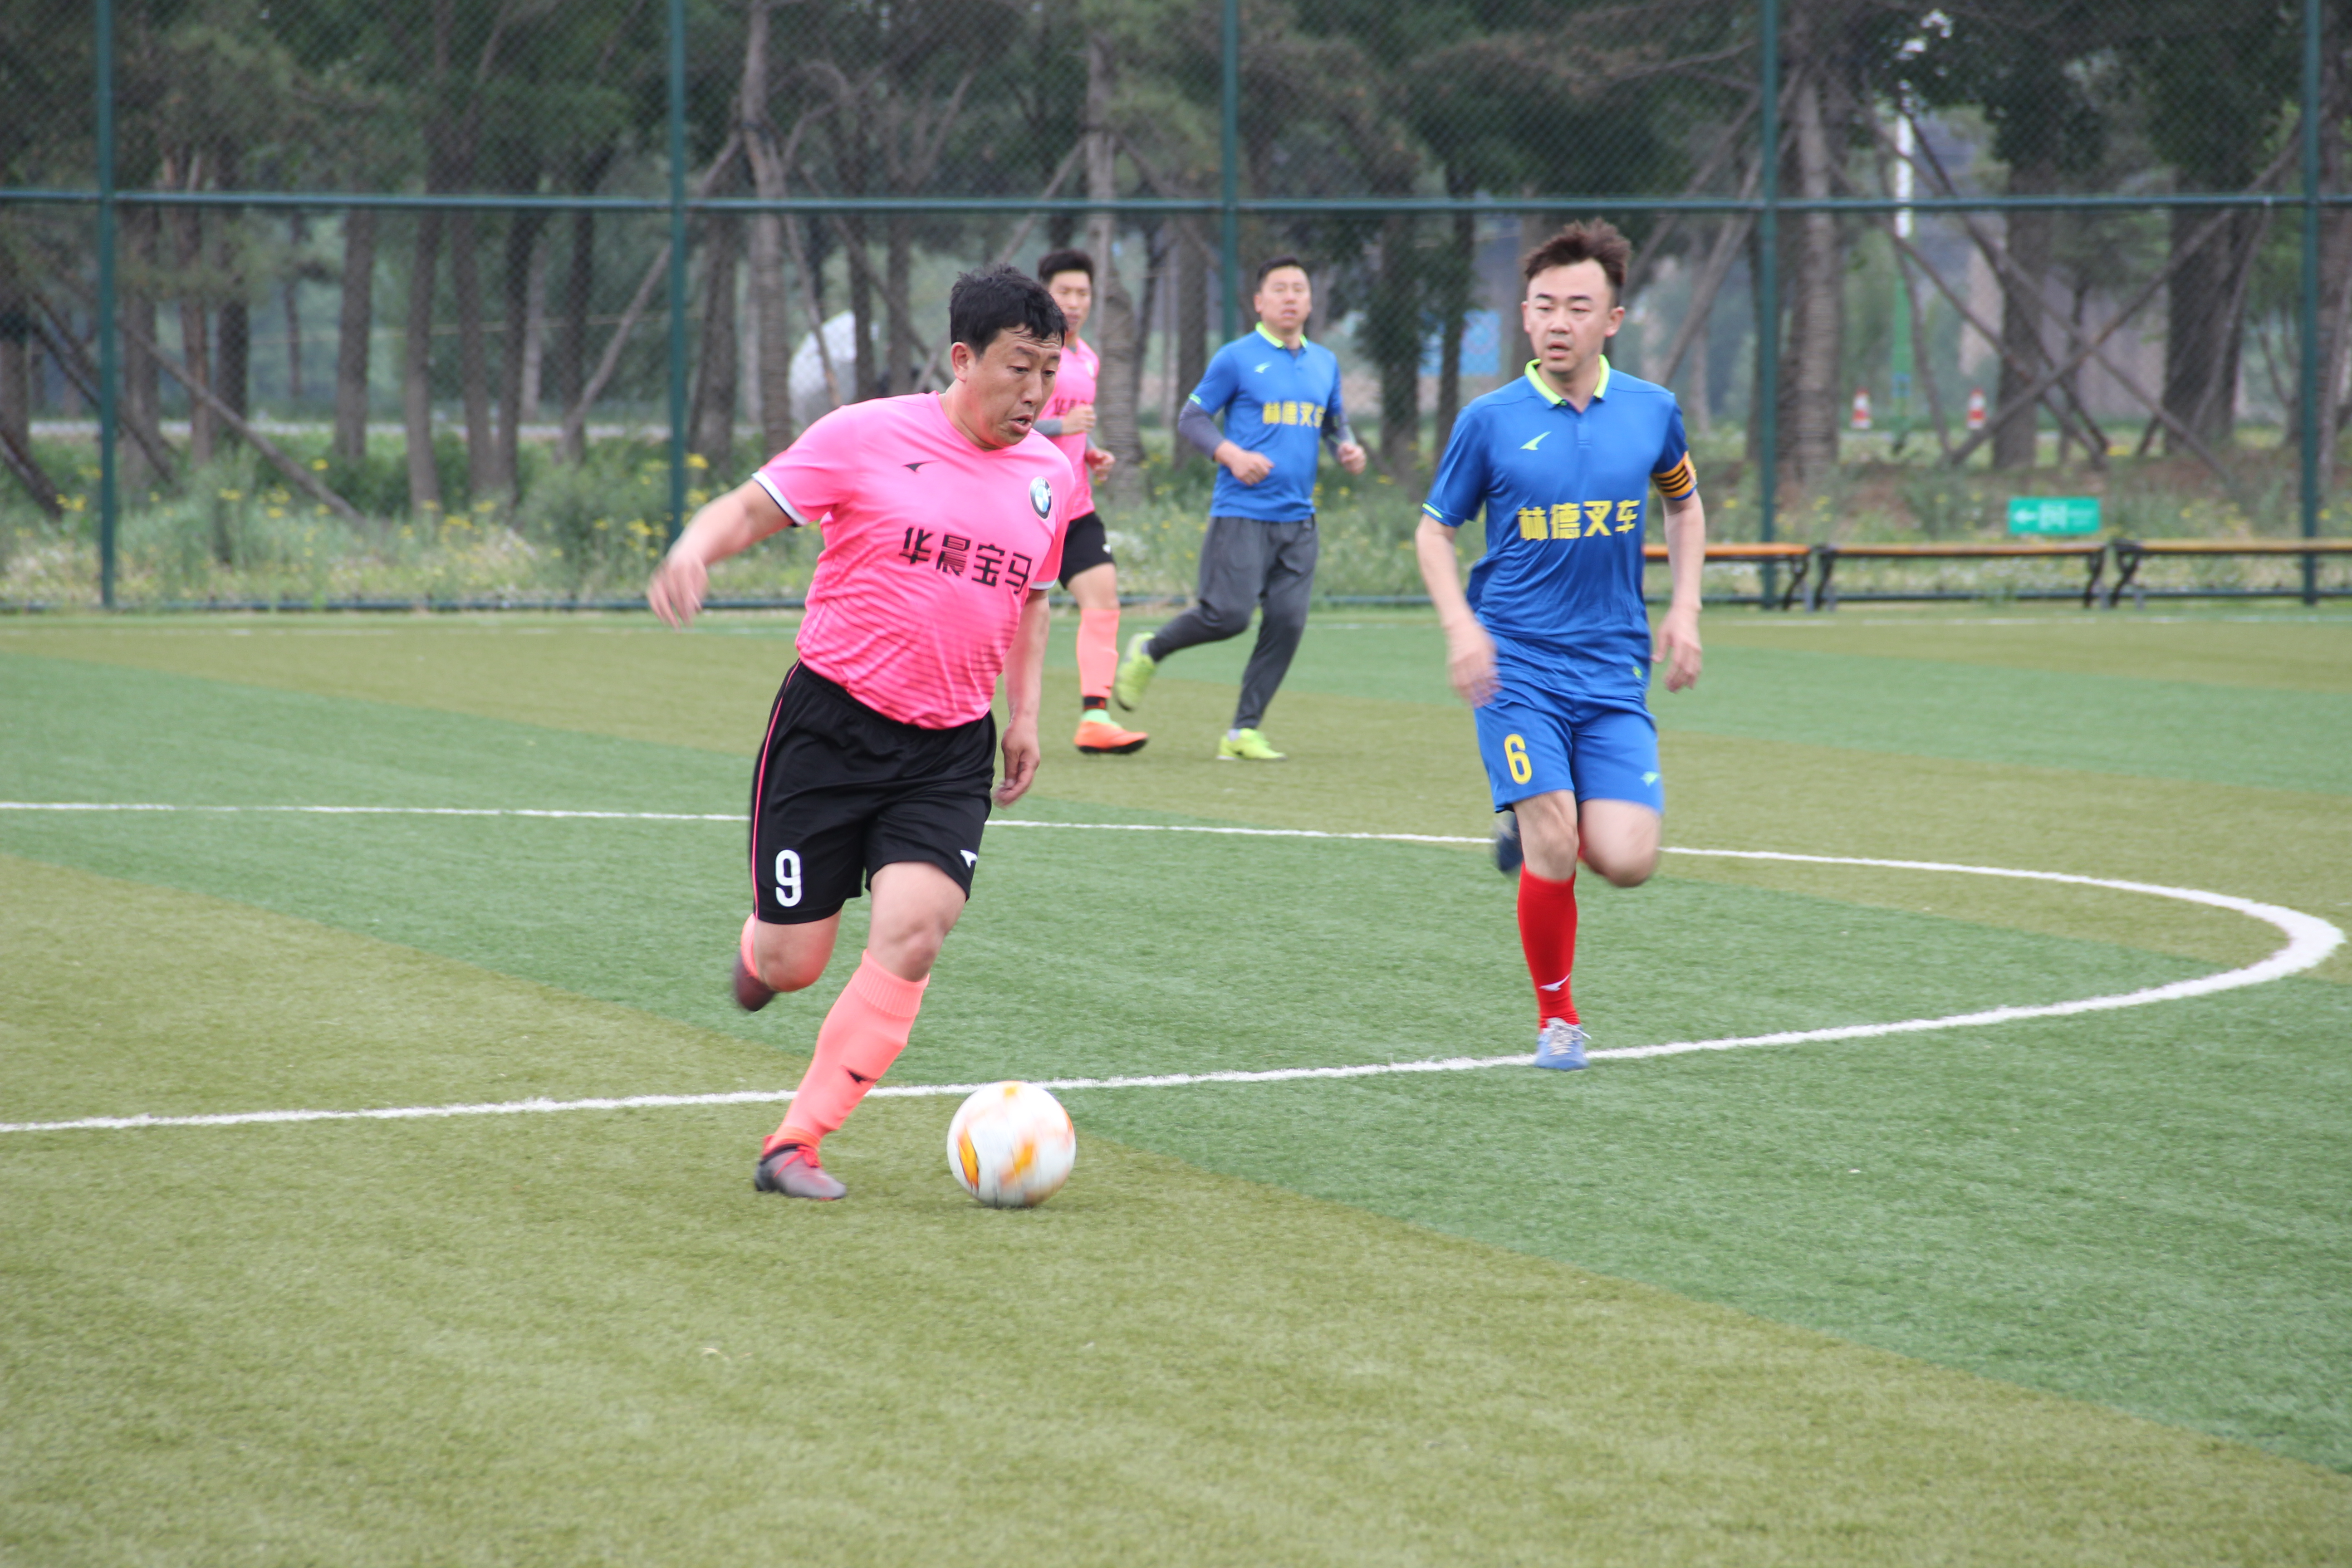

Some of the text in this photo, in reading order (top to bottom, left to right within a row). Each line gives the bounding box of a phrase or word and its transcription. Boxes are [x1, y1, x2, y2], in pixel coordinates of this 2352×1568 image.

[1518, 500, 1640, 541] 林德叉车
[899, 527, 1032, 594] 华晨宝马
[1504, 734, 1532, 784] 6
[775, 849, 802, 907] 9
